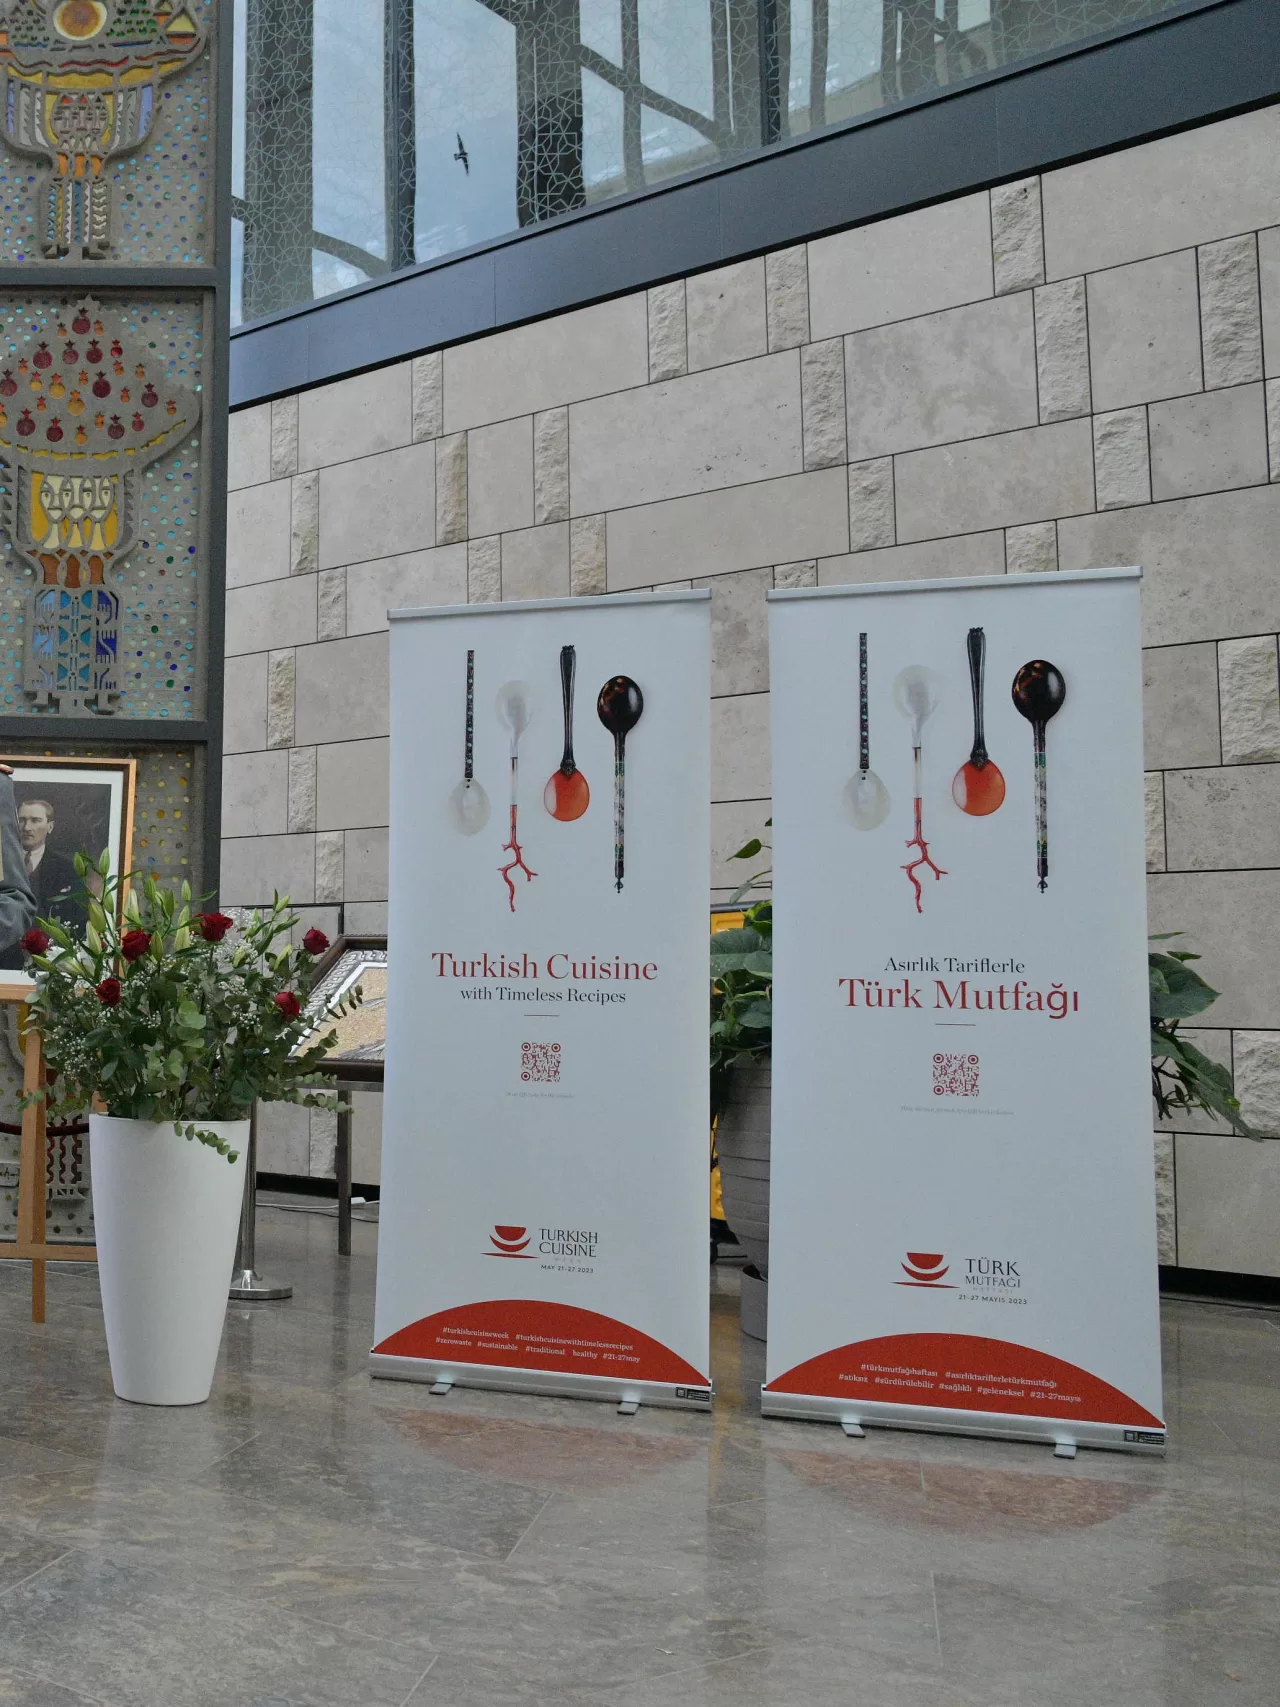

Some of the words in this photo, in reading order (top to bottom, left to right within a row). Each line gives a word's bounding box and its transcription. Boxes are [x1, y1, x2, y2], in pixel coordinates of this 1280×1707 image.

[431, 952, 539, 978] Turkish
[547, 953, 658, 980] Cuisine
[884, 956, 940, 972] Asırlık
[944, 957, 1025, 973] Tariflerle
[460, 986, 492, 1000] with
[495, 986, 563, 1001] Timeless
[567, 988, 626, 1006] Recipes
[838, 978, 923, 1008] Türk
[932, 979, 1079, 1019] Mutfağı
[539, 1228, 598, 1244] TURKISH
[539, 1241, 597, 1258] CUISINE
[964, 1256, 1020, 1276] TÜRK
[965, 1275, 1021, 1288] MUTFAĞI
[1008, 1297, 1028, 1305] 2023
[442, 1327, 509, 1339] #turkishcuisineweek
[515, 1334, 634, 1351] #turkishcuisinewithtimelessrecipes
[435, 1336, 472, 1346] #zerowaste
[477, 1341, 518, 1351] #sustainable
[525, 1345, 565, 1355] #traditional
[572, 1349, 598, 1359] healthy
[602, 1352, 641, 1363] #21-27may
[874, 1377, 935, 1389] #sürdürülebilir
[977, 1386, 1024, 1397] #geleneksel
